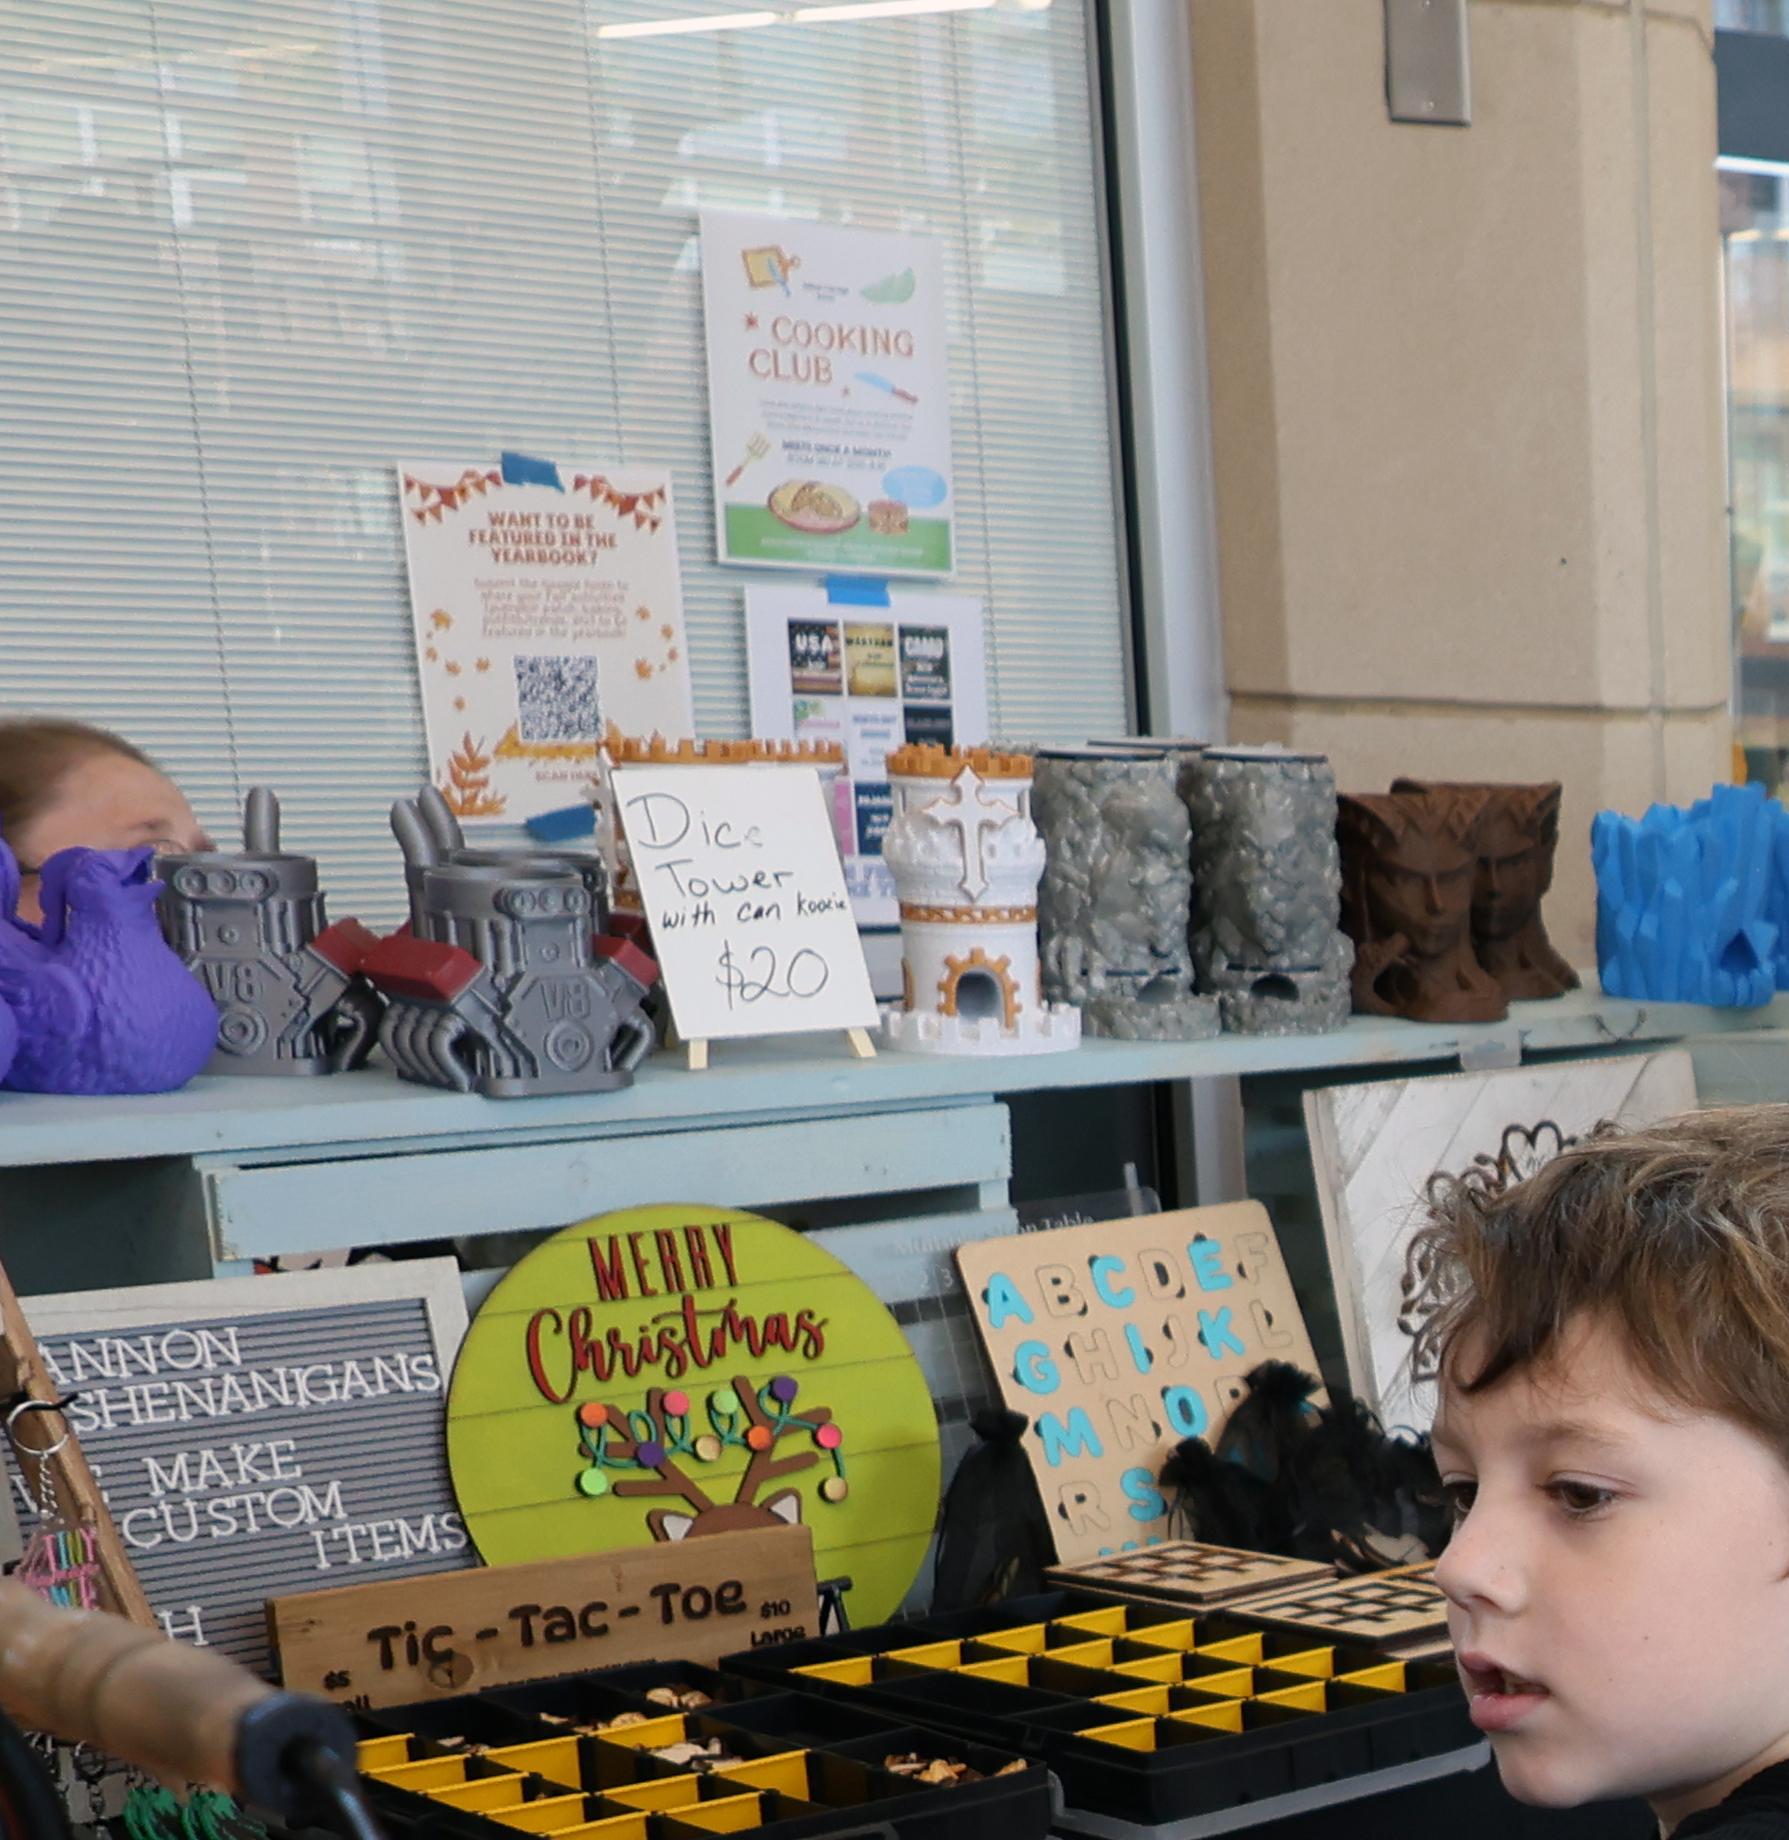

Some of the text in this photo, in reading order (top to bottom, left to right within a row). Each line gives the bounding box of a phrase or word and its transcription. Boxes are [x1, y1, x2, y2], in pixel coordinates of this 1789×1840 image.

[771, 315, 914, 357] COOKING
[749, 348, 833, 385] CLUB
[469, 530, 617, 549] FEATURED IN THE
[488, 511, 595, 530] WANT TO BE
[491, 549, 598, 567] YEARBOOK?
[795, 633, 834, 656] USA
[627, 792, 763, 849] Dice
[655, 858, 794, 897] Tower
[662, 902, 716, 929] with
[737, 902, 782, 923] can
[716, 938, 829, 1011] $20
[587, 1222, 739, 1302] MERRY
[987, 1272, 1034, 1329] A
[1035, 1264, 1087, 1319] B
[1090, 1254, 1136, 1309] C
[1137, 1248, 1184, 1301] D
[1187, 1238, 1233, 1292] E
[37, 1326, 244, 1387] ANNON
[525, 1293, 829, 1405] Christmas
[1014, 1339, 1061, 1395] G
[1068, 1327, 1119, 1385] H
[1197, 1305, 1245, 1361] K
[70, 1352, 442, 1437] SHENANIGANS
[1039, 1407, 1104, 1468] M
[1163, 1384, 1208, 1437] O
[141, 1438, 304, 1498] MAKE
[1119, 1466, 1167, 1523] S
[121, 1479, 349, 1551] CUSTOM
[308, 1510, 470, 1572] ITEMS
[760, 1598, 791, 1620] $10
